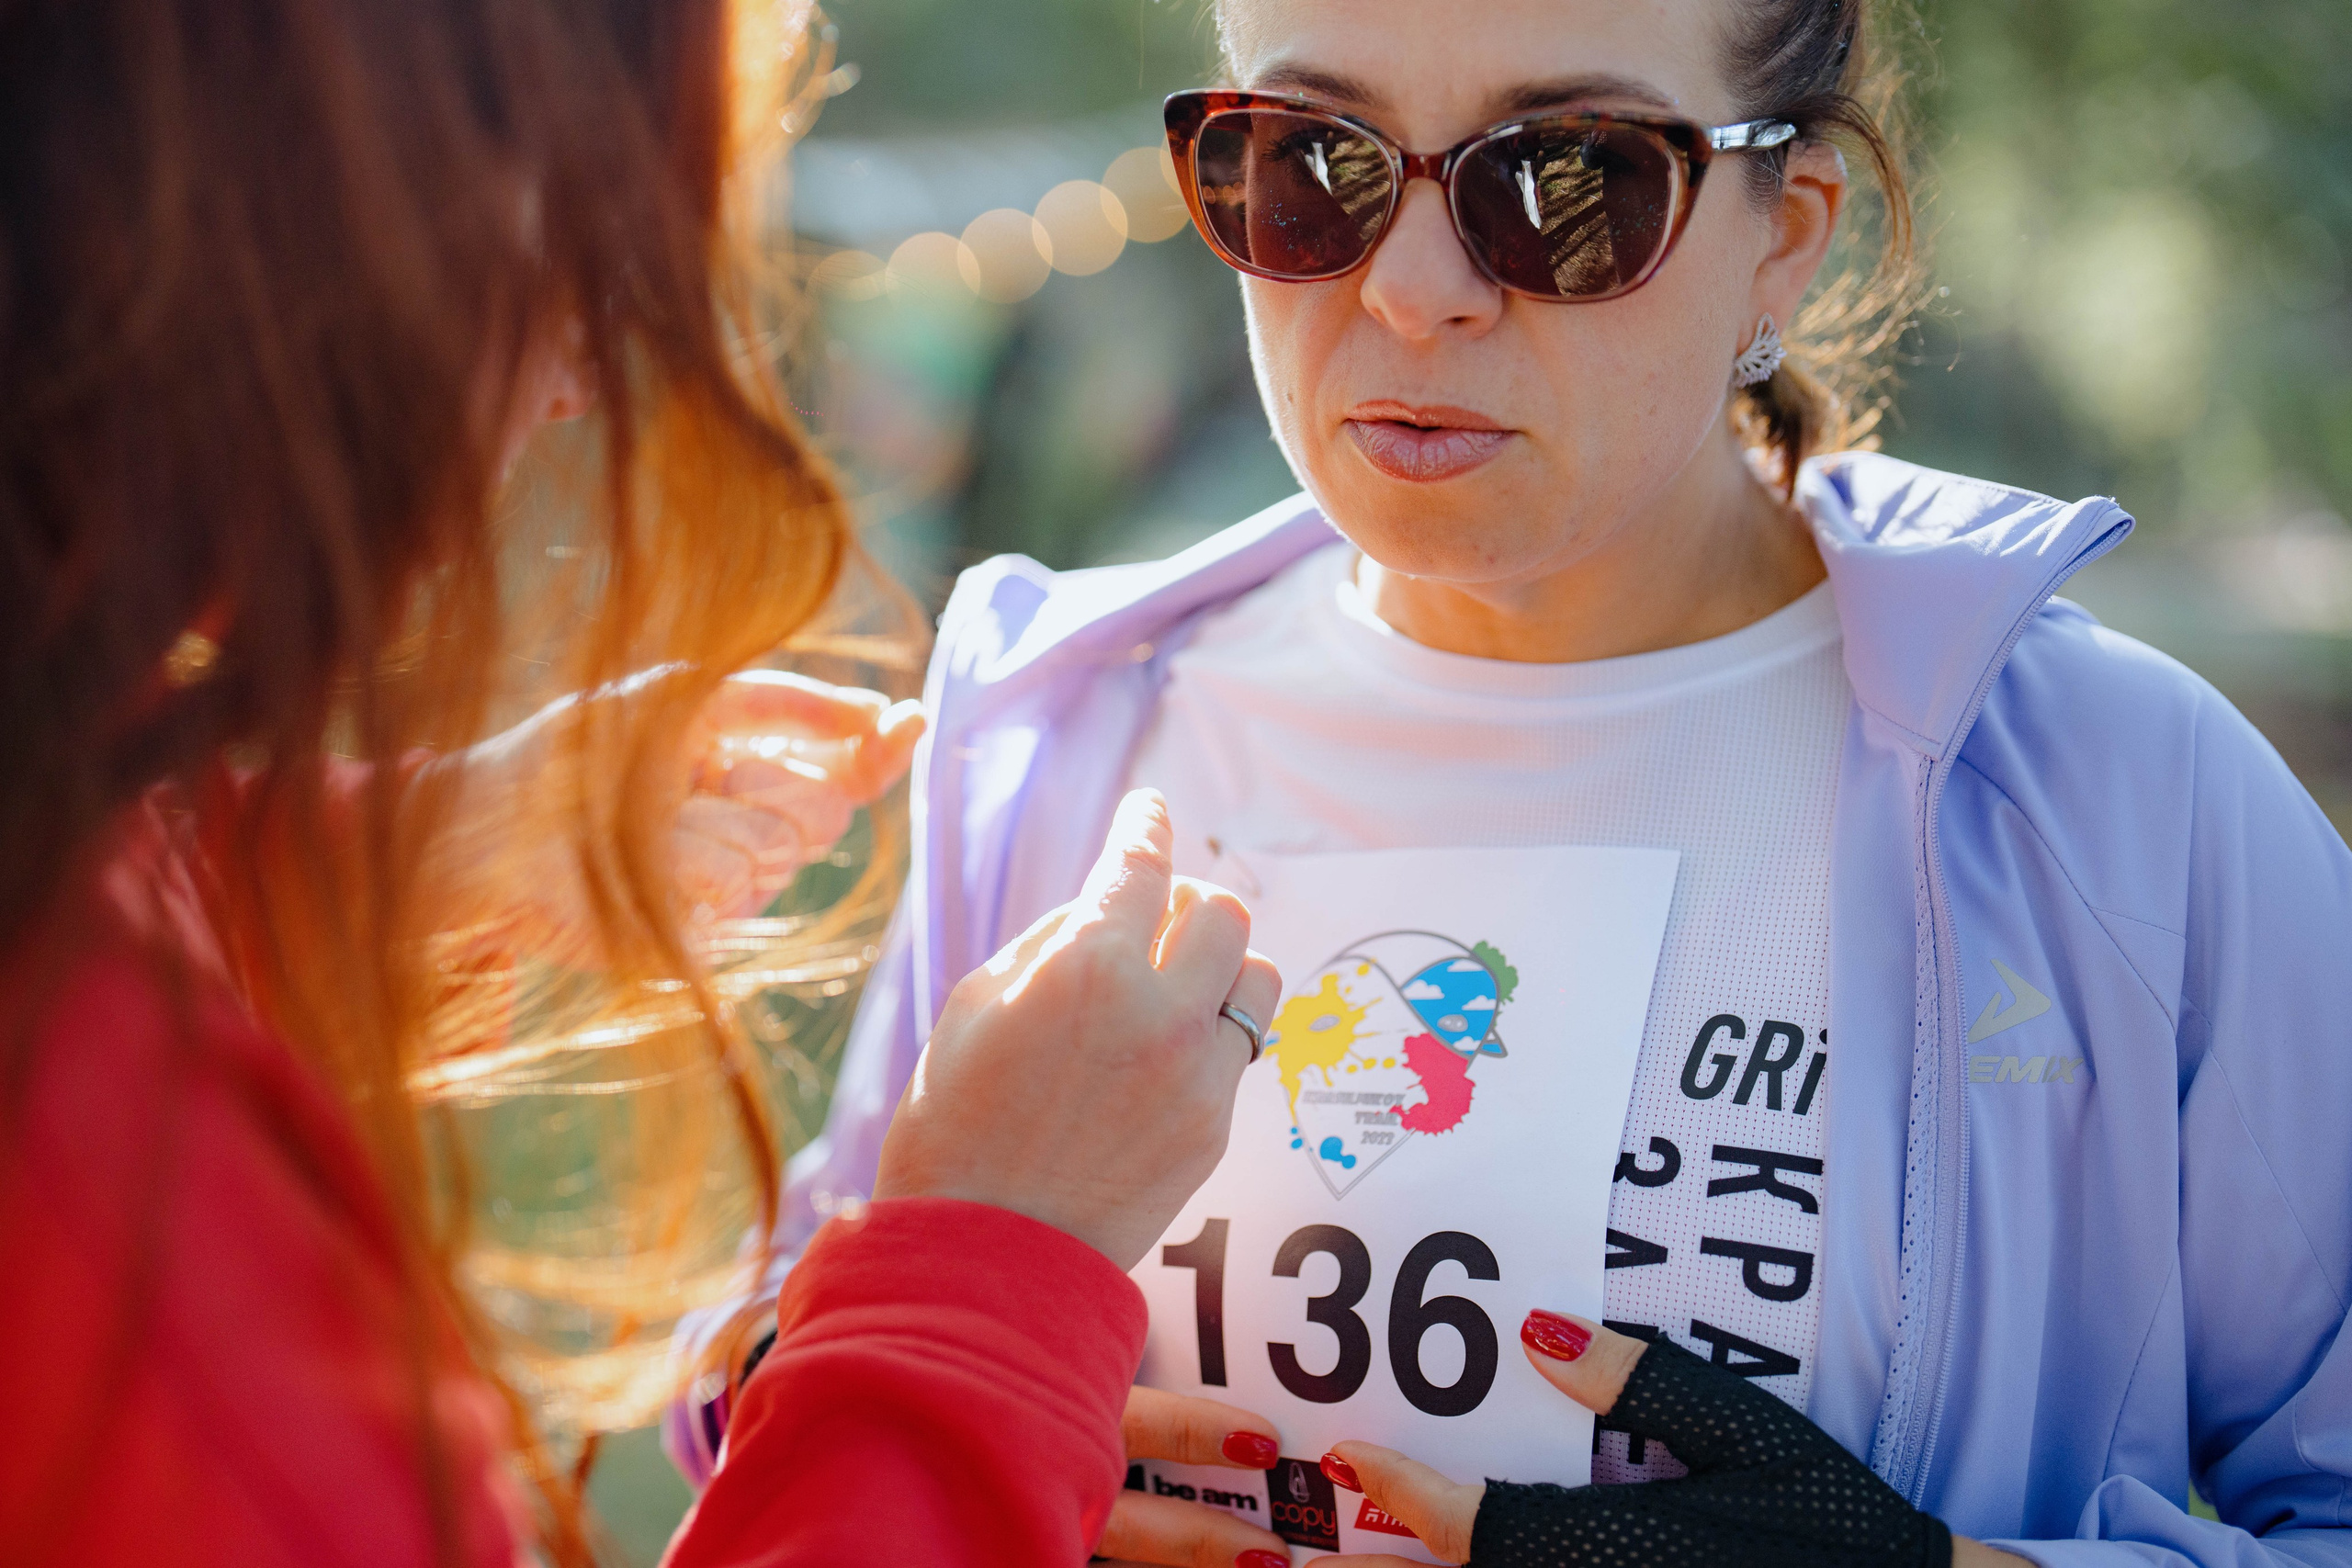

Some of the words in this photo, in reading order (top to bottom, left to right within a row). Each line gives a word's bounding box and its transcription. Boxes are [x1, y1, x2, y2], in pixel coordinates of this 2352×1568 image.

[1162, 1218, 1501, 1417] 136
[1153, 1473, 1197, 1501] be
[1202, 1486, 1260, 1512] am
[1271, 1499, 1336, 1535] copy
